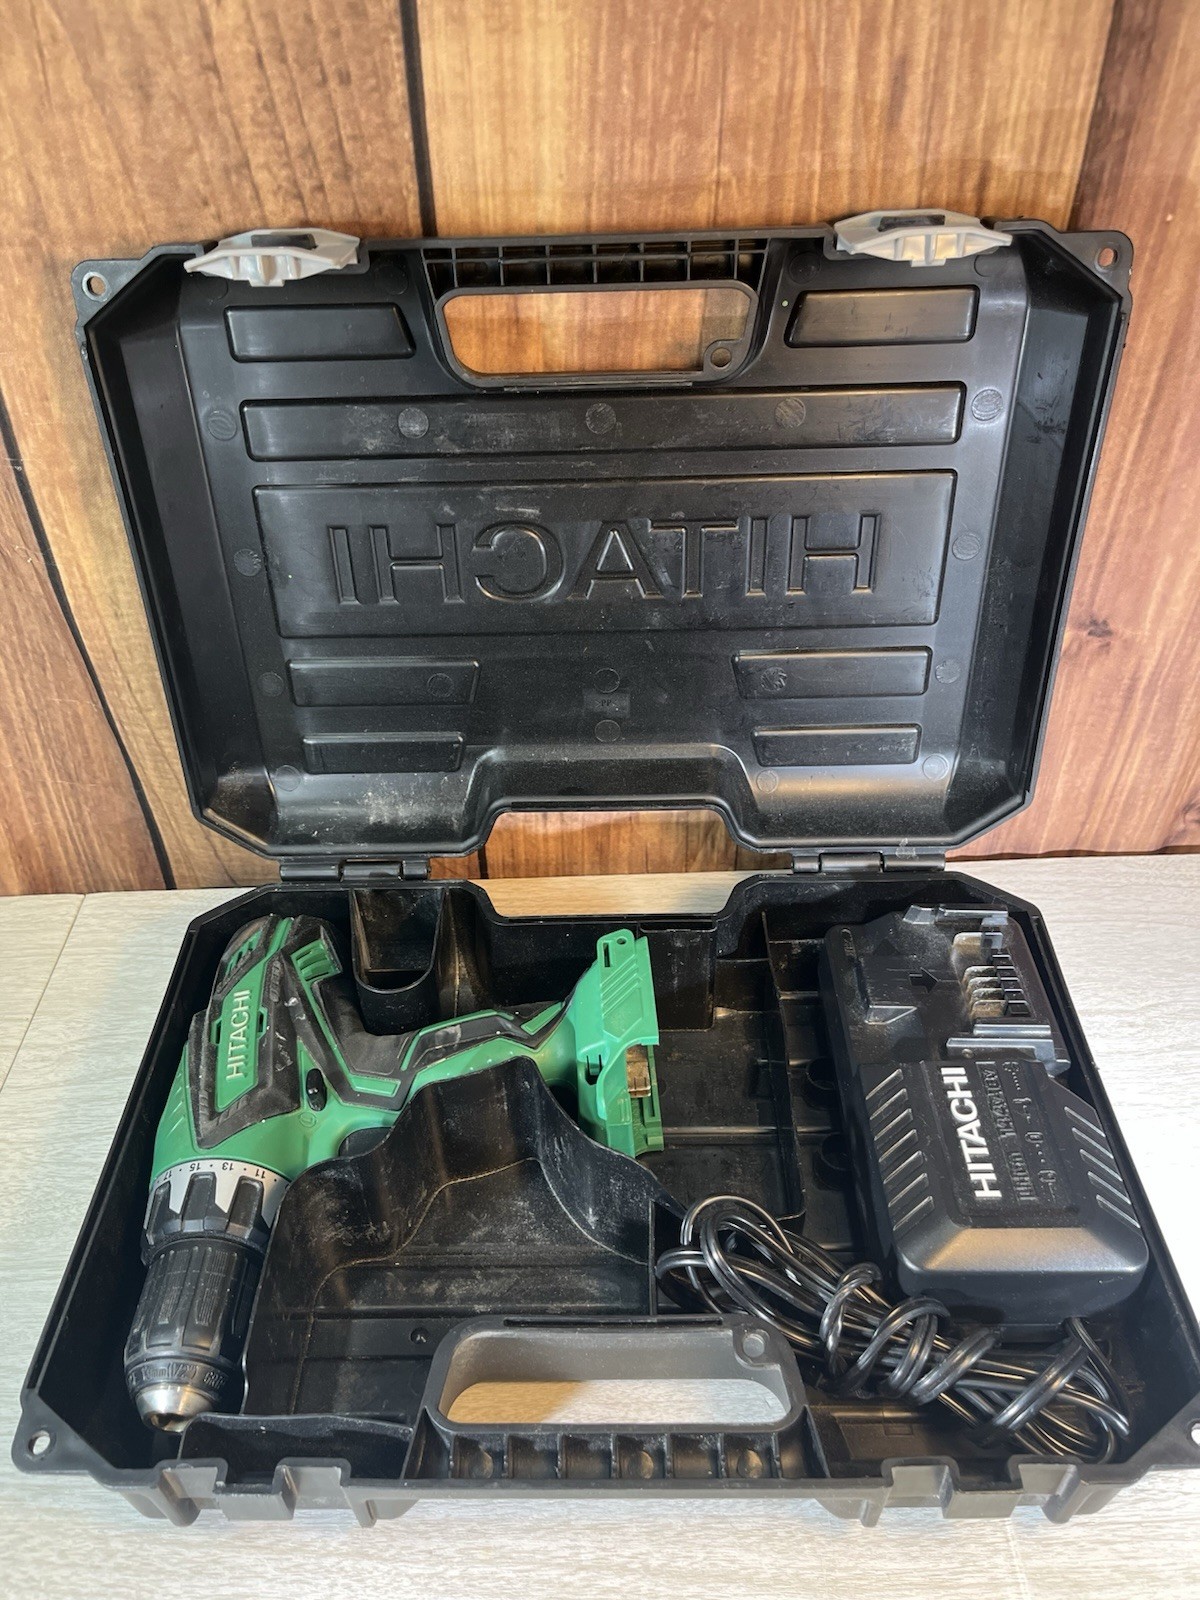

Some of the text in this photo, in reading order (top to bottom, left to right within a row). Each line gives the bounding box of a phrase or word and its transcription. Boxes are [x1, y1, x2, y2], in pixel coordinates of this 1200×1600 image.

[225, 989, 251, 1082] HITACHI
[163, 1162, 266, 1181] 11 13 15 17
[940, 1066, 1003, 1198] HITACHI
